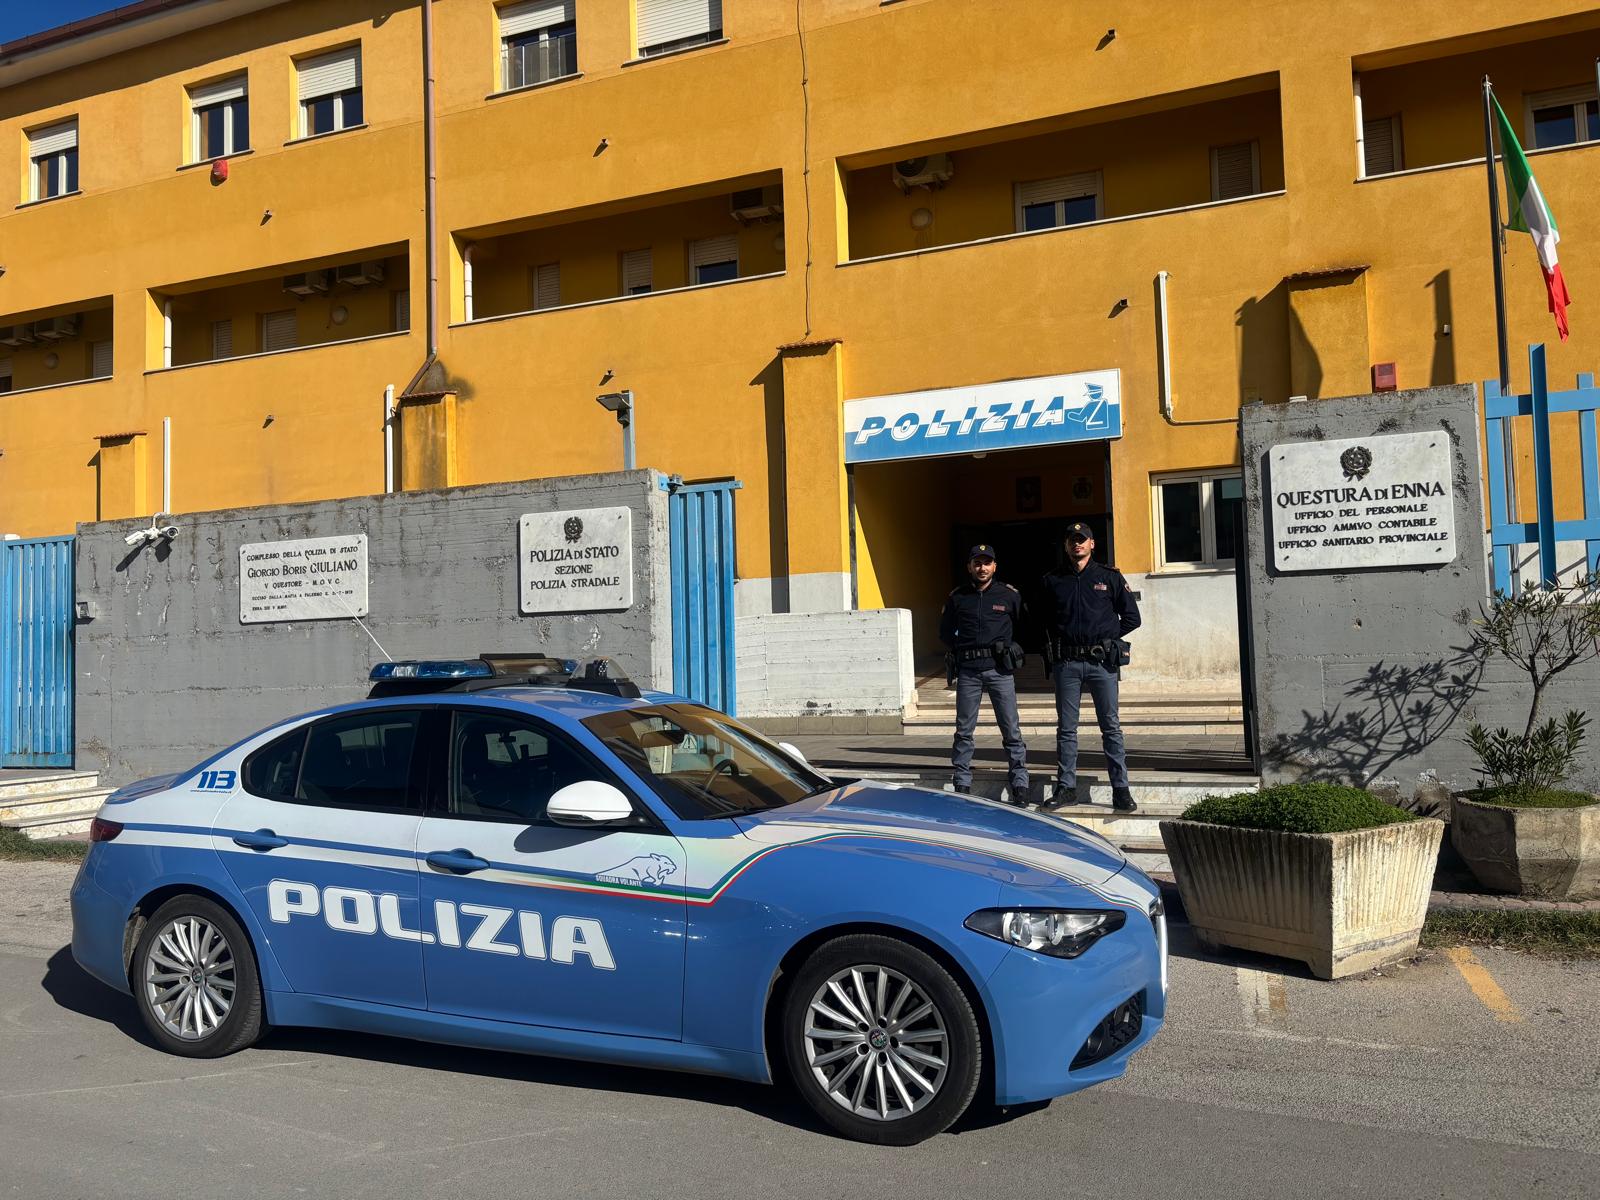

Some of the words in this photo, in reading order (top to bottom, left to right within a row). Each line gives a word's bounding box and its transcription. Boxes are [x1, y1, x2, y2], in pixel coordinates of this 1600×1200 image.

[854, 395, 1065, 445] POLIZIA
[1276, 486, 1373, 508] QUESTURA
[1391, 481, 1446, 499] ENNA
[1294, 509, 1334, 520] UFFICIO
[1339, 507, 1360, 517] DEL
[1365, 503, 1428, 516] PERSONALE
[1287, 524, 1327, 535] UFFICIO
[1378, 517, 1438, 529] CONTABILE
[1278, 538, 1317, 550] UFFICIO
[1322, 535, 1374, 547] SANITARIO
[1378, 531, 1448, 544] PROVINCIALE
[246, 552, 280, 562] COMPLESSO
[304, 548, 327, 557] POLIZIA
[340, 546, 358, 554] STATO
[530, 548, 573, 562] POLIZIA
[584, 545, 619, 559] STATO
[310, 559, 358, 573] GIULIANO
[554, 564, 593, 575] SEZIONE
[272, 580, 303, 589] QUESTORE
[530, 580, 566, 590] POLIZIA
[571, 576, 620, 588] STRADALE
[197, 770, 237, 789] 113
[266, 878, 617, 971] POLIZIA
